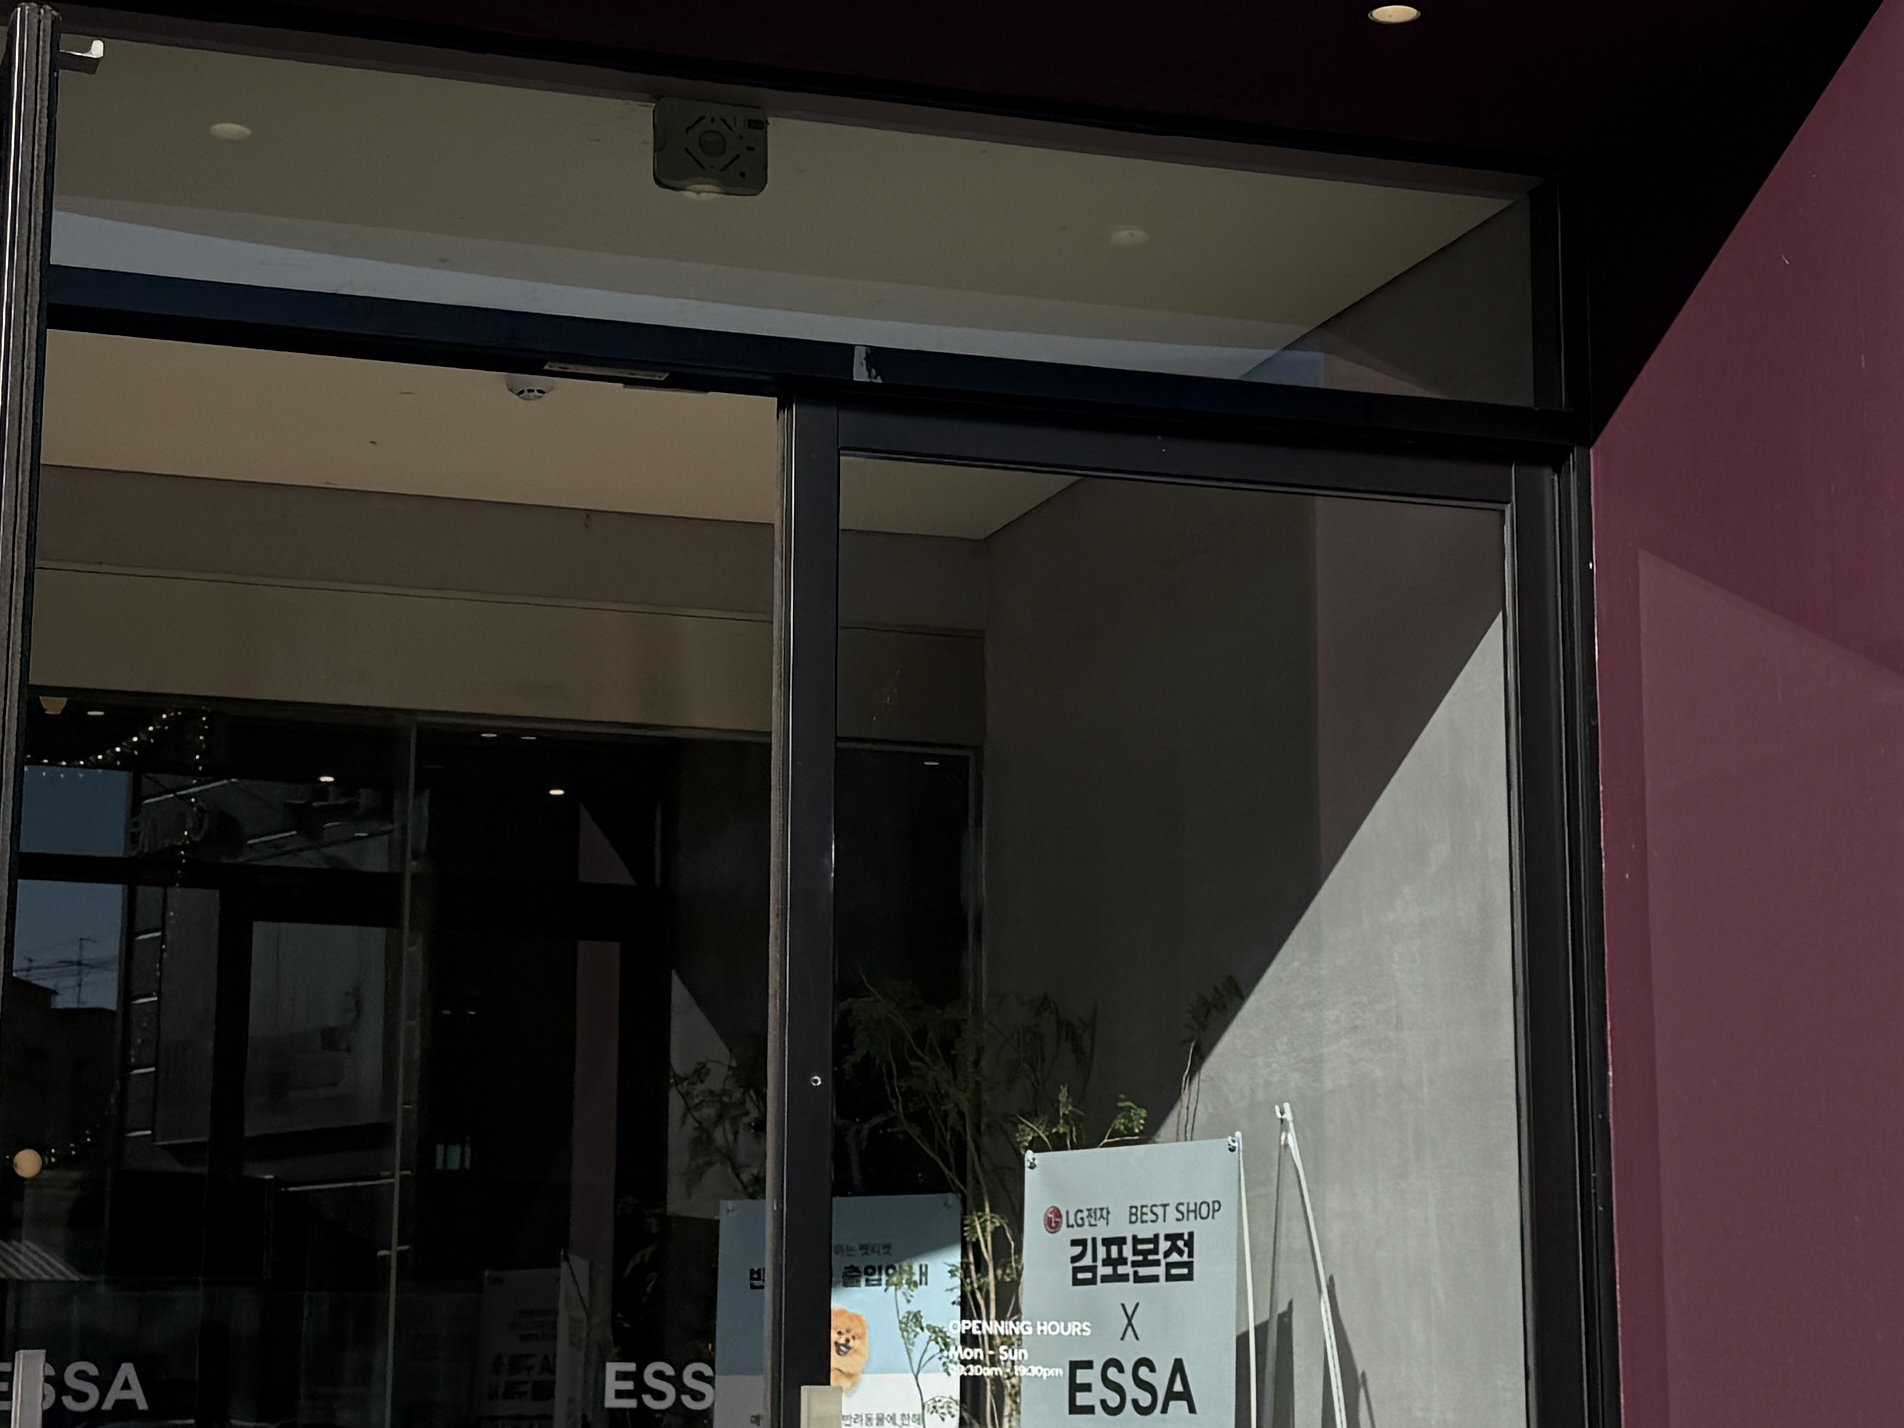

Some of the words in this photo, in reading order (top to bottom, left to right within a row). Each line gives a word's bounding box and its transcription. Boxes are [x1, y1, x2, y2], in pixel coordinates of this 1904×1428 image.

[1065, 1206, 1111, 1229] LG전자
[1128, 1203, 1170, 1224] BEST
[1175, 1200, 1222, 1222] SHOP
[1070, 1231, 1195, 1286] 김포본점
[948, 1320, 1033, 1336] OPENNING
[1036, 1320, 1092, 1336] HOURS
[949, 1345, 984, 1360] Mon
[999, 1345, 1029, 1361] Sun
[604, 1361, 715, 1410] ESS
[1068, 1357, 1197, 1416] ESSA
